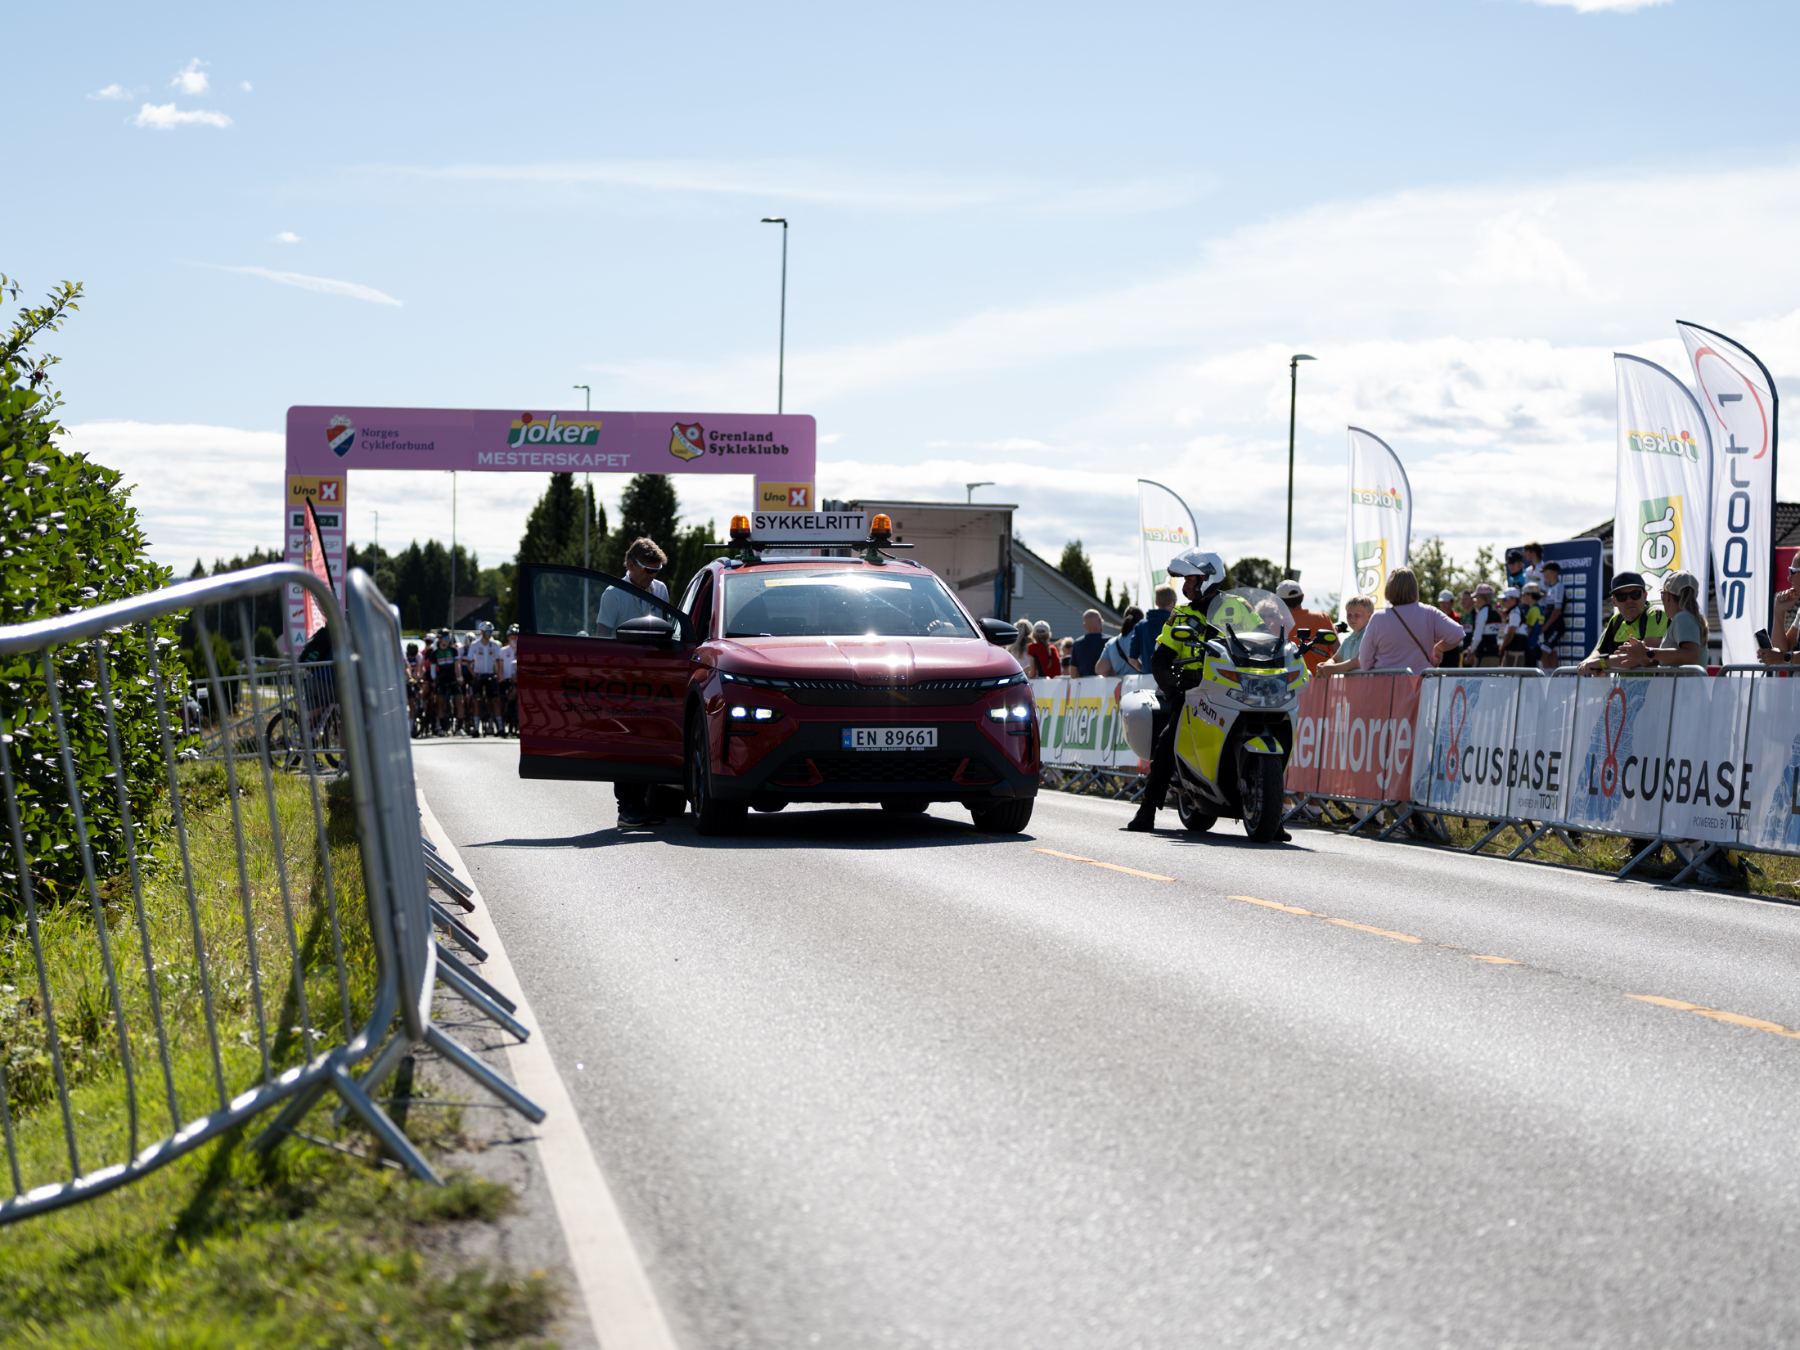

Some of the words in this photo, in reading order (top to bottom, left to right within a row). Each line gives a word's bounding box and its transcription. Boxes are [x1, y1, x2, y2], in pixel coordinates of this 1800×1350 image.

[1717, 393, 1744, 408] 1
[361, 427, 400, 439] Norges
[511, 412, 595, 448] joker
[709, 431, 773, 442] Grenland
[361, 440, 435, 452] Cykleforbund
[709, 443, 789, 456] Sykleklubb
[477, 452, 631, 467] MESTERSKAPET
[293, 485, 317, 496] Uno
[321, 482, 338, 500] X
[764, 491, 786, 502] Uno
[790, 488, 806, 506] X
[755, 515, 864, 530] SYKKELRITT
[1721, 433, 1752, 620] sport
[1198, 698, 1217, 721] POLITI
[856, 730, 877, 746] EN
[885, 730, 933, 746] 89661
[1436, 743, 1562, 791] LOCUSBASE
[1588, 753, 1753, 810] LOCUSBASE
